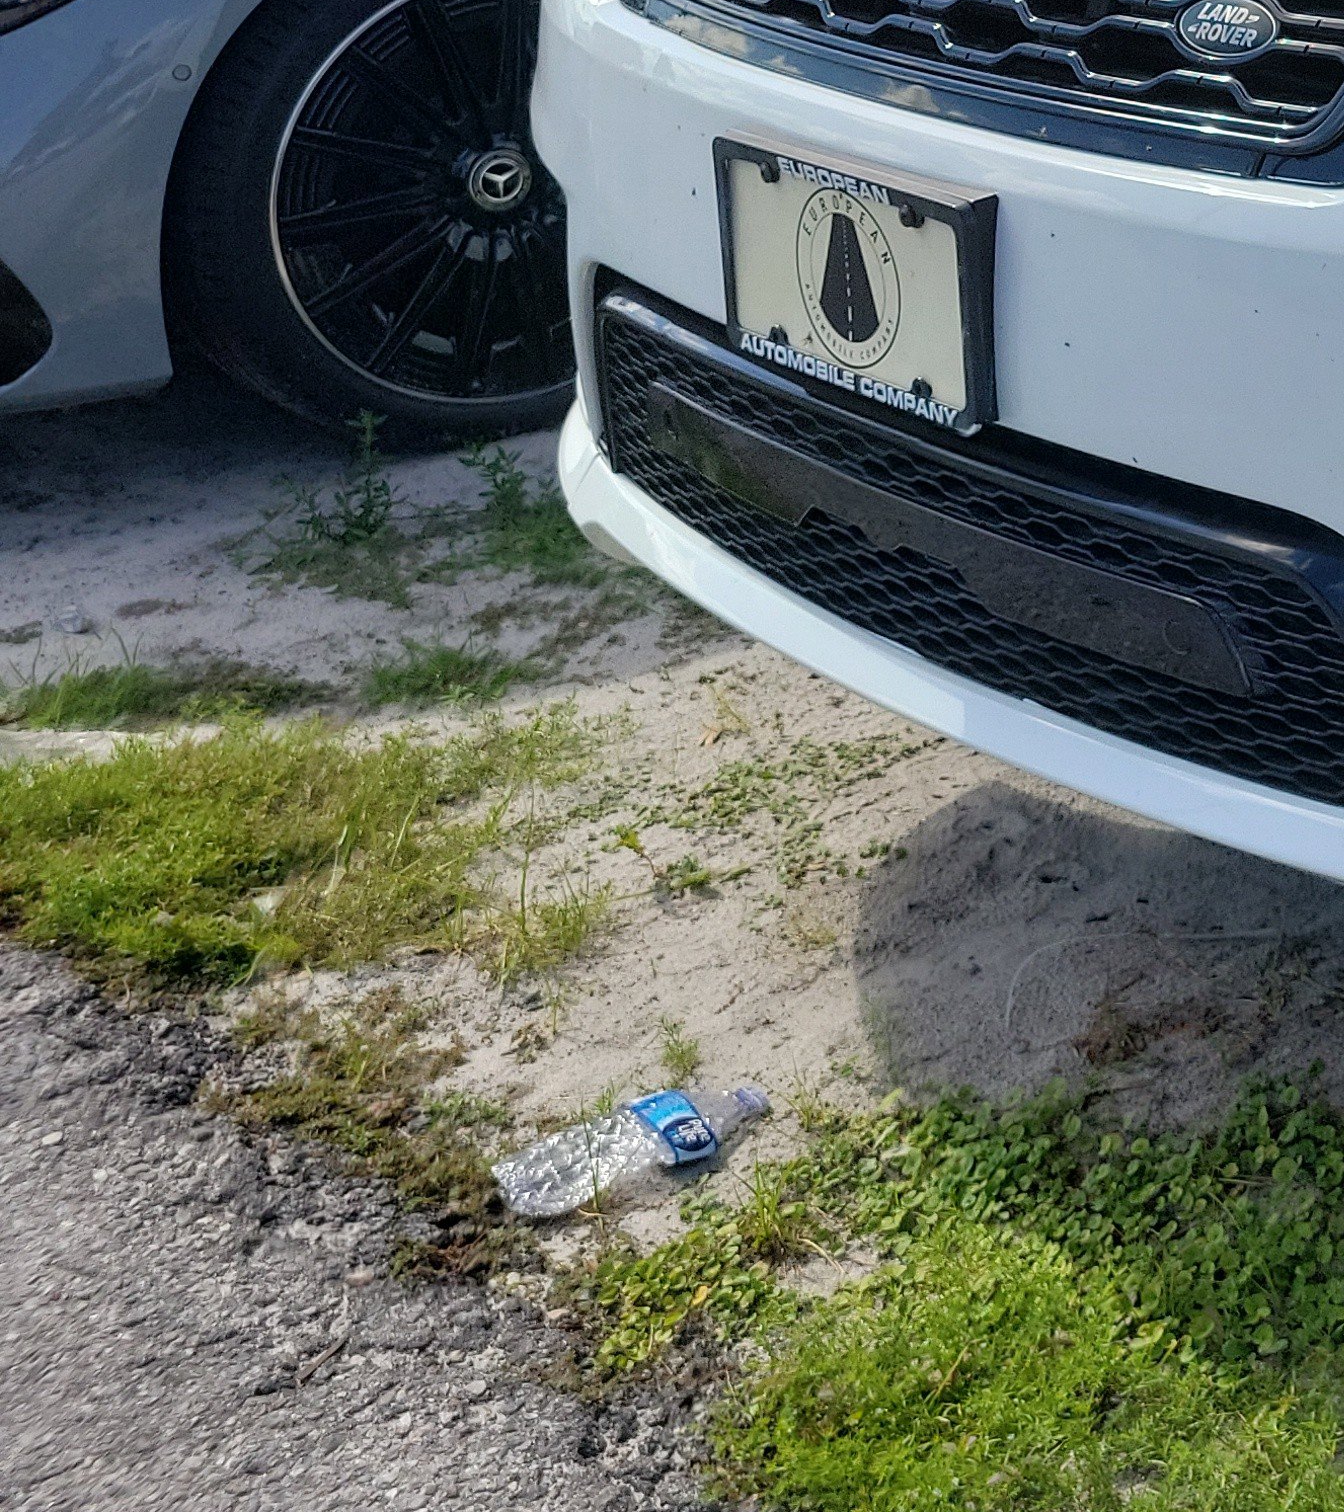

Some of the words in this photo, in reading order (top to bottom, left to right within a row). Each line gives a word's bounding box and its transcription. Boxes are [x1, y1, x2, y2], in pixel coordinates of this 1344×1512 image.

[1194, 21, 1258, 48] ROVER
[1197, 1, 1249, 24] LAND
[776, 155, 891, 206] EUROPEAN
[802, 193, 891, 266] EUROPEAN
[740, 333, 856, 392] AUTOMOBILE
[859, 376, 959, 428] COMPANY
